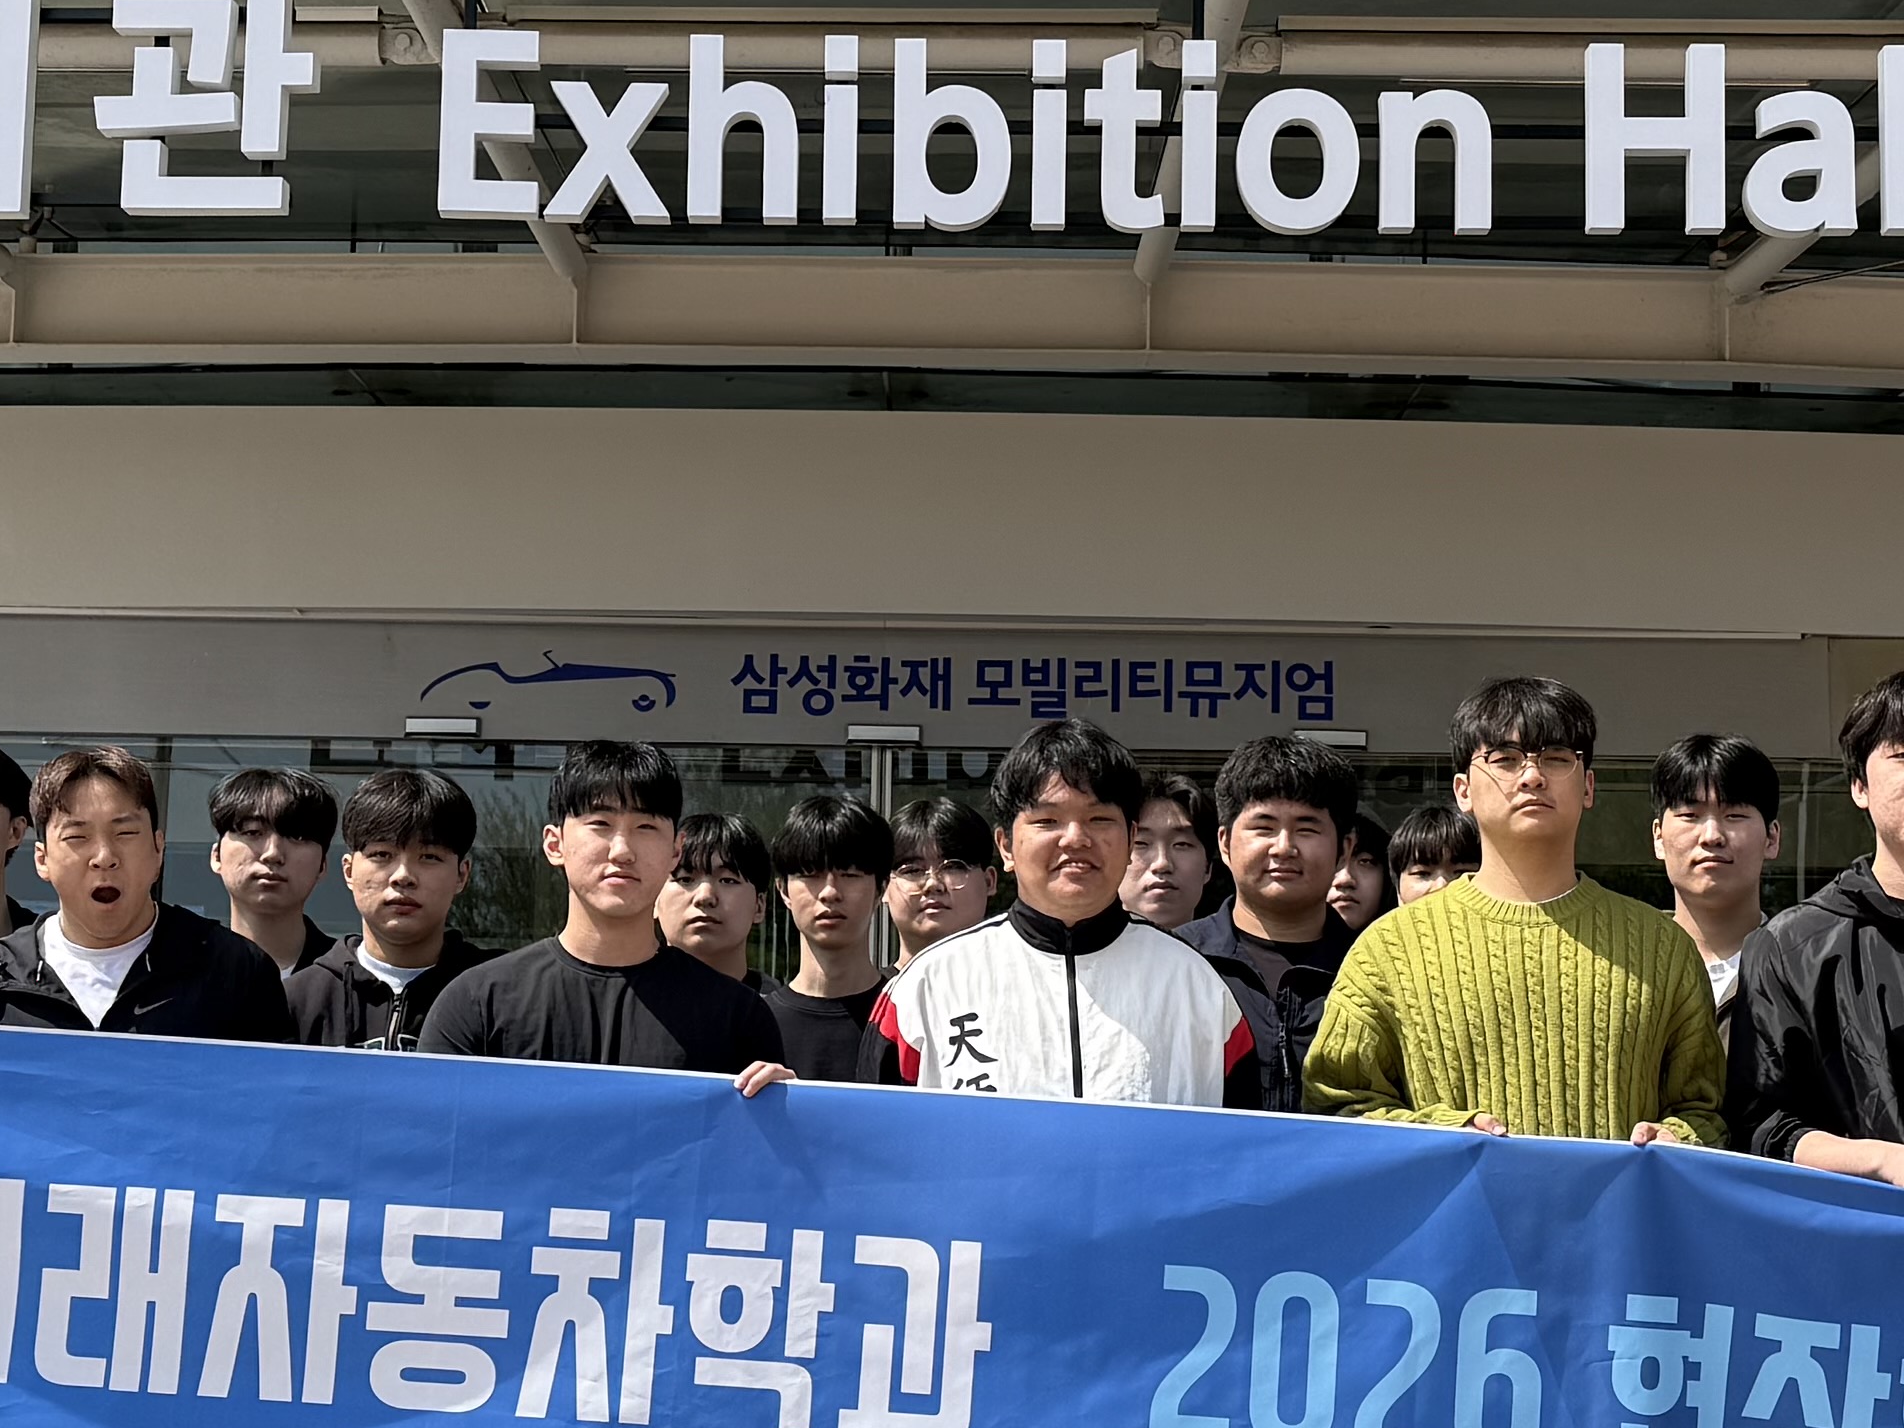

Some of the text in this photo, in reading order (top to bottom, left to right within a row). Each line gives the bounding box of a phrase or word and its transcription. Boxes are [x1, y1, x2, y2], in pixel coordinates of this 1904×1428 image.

[438, 28, 1494, 239] Exhibition
[731, 654, 1336, 722] 삼성화재 모빌리티뮤지엄
